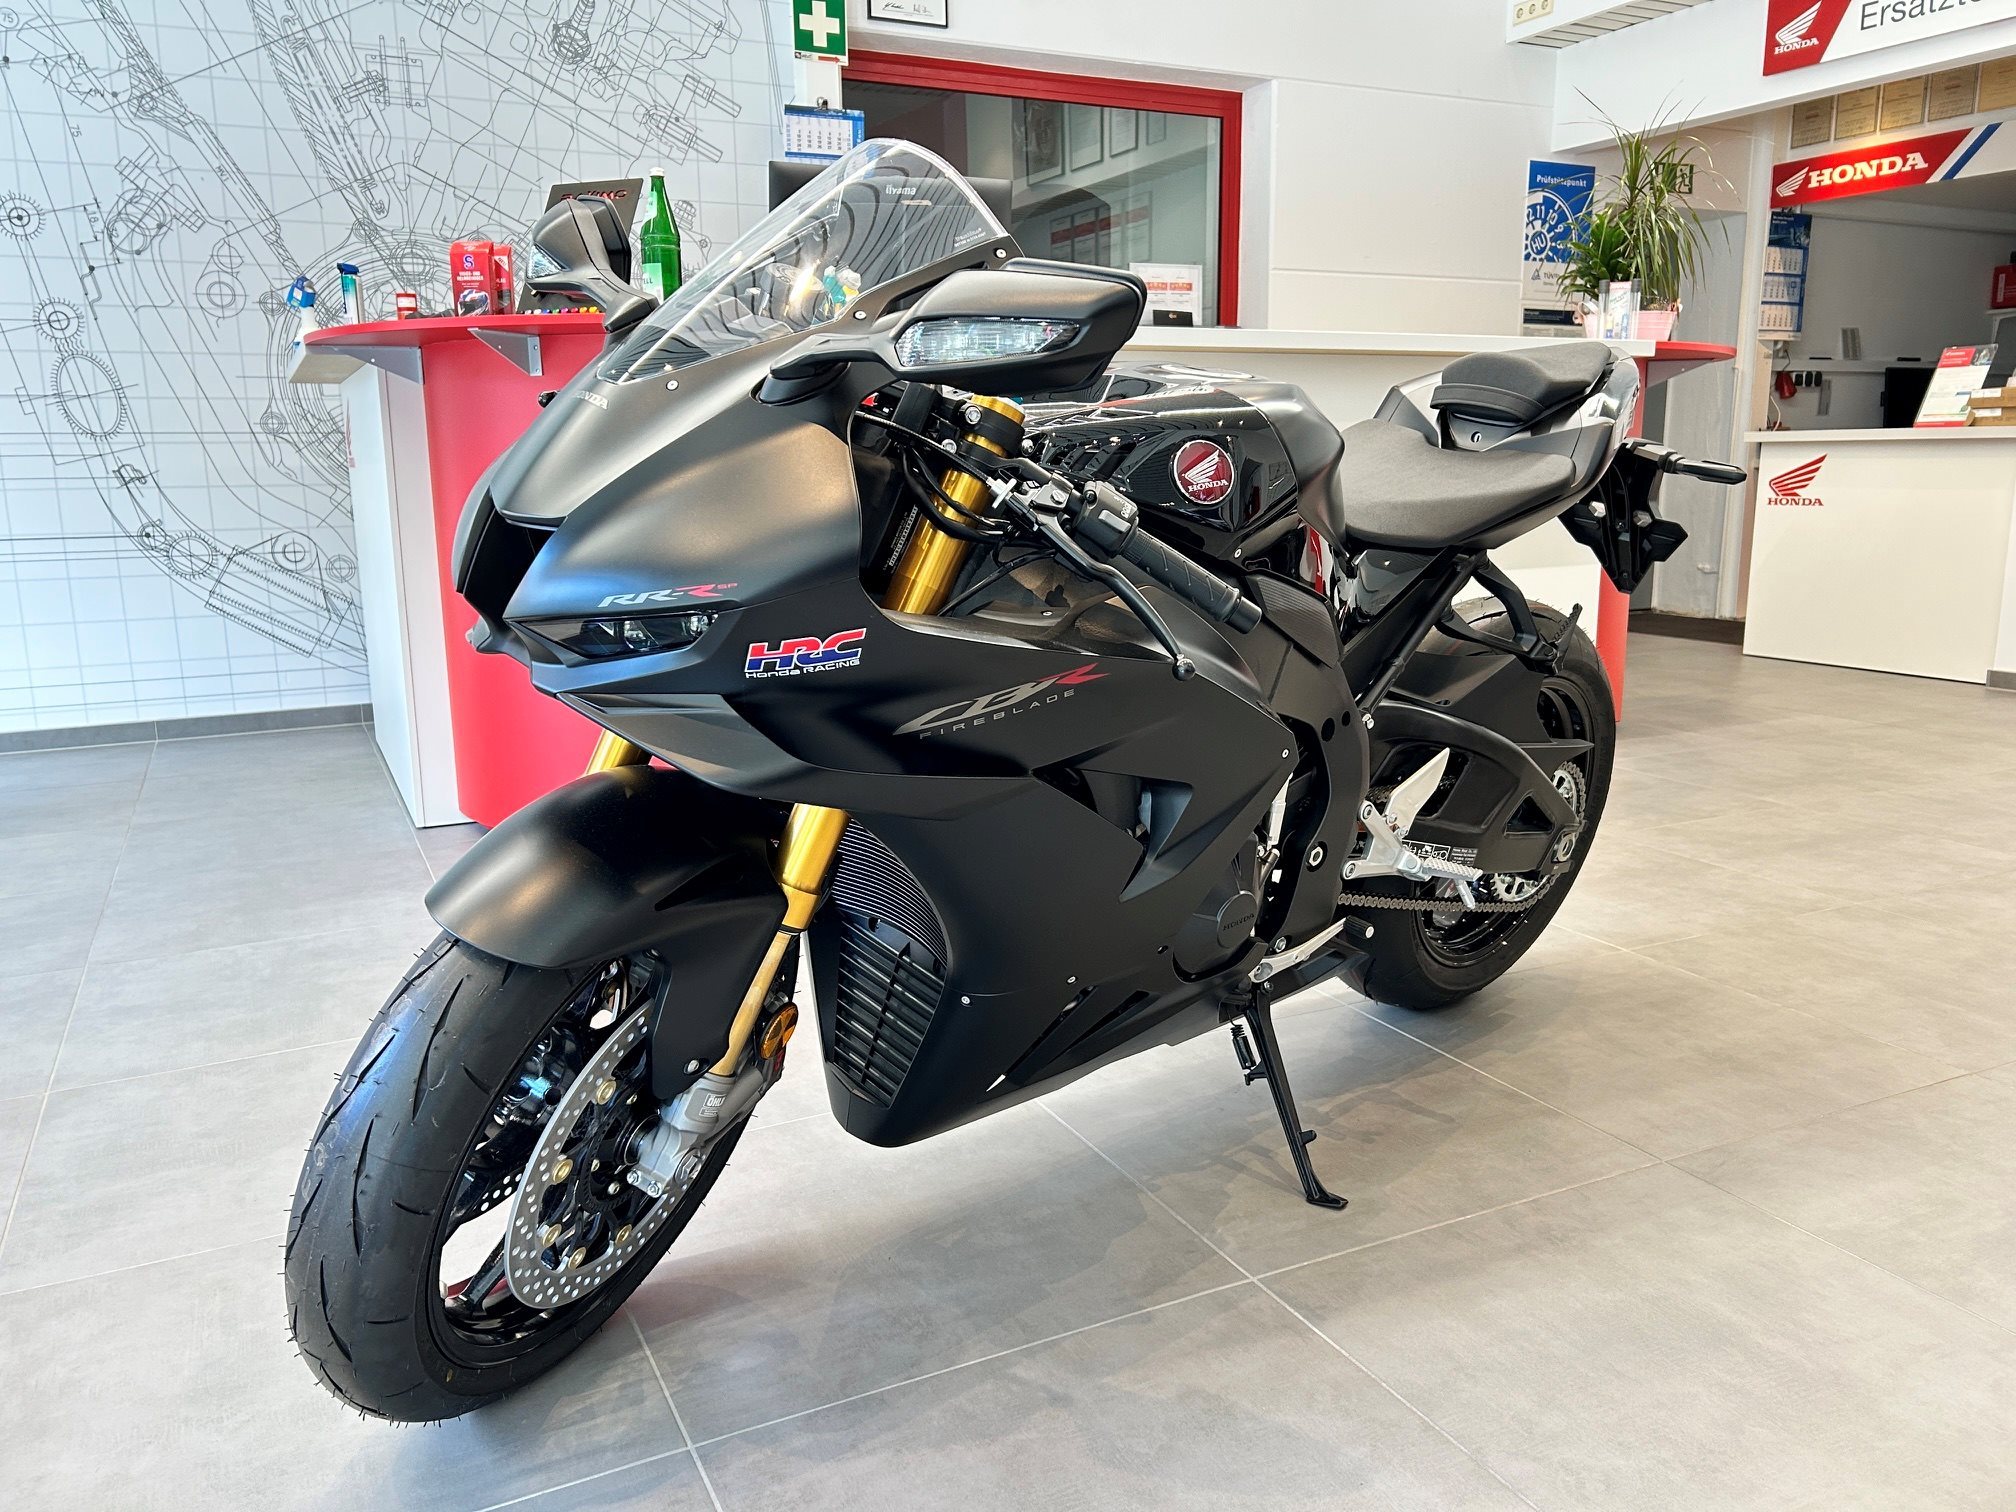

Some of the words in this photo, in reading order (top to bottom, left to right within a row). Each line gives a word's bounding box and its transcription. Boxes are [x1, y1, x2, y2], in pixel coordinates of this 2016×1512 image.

[1, 12, 14, 23] 75
[1860, 0, 1981, 31] Ersatz
[1774, 37, 1820, 55] HONDA
[70, 124, 82, 138] 75
[1807, 151, 1929, 189] HONDA
[1536, 205, 1545, 219] 11
[1531, 234, 1547, 254] HU
[576, 389, 609, 410] ONDA
[1187, 479, 1230, 493] HONDA
[1767, 497, 1825, 507] HONDA
[744, 627, 867, 673] HRC
[745, 668, 801, 679] Honda
[803, 658, 861, 674] RACING
[892, 662, 1110, 736] CBR
[919, 688, 1076, 740] FIREBLADE
[1222, 912, 1255, 932] HONDA
